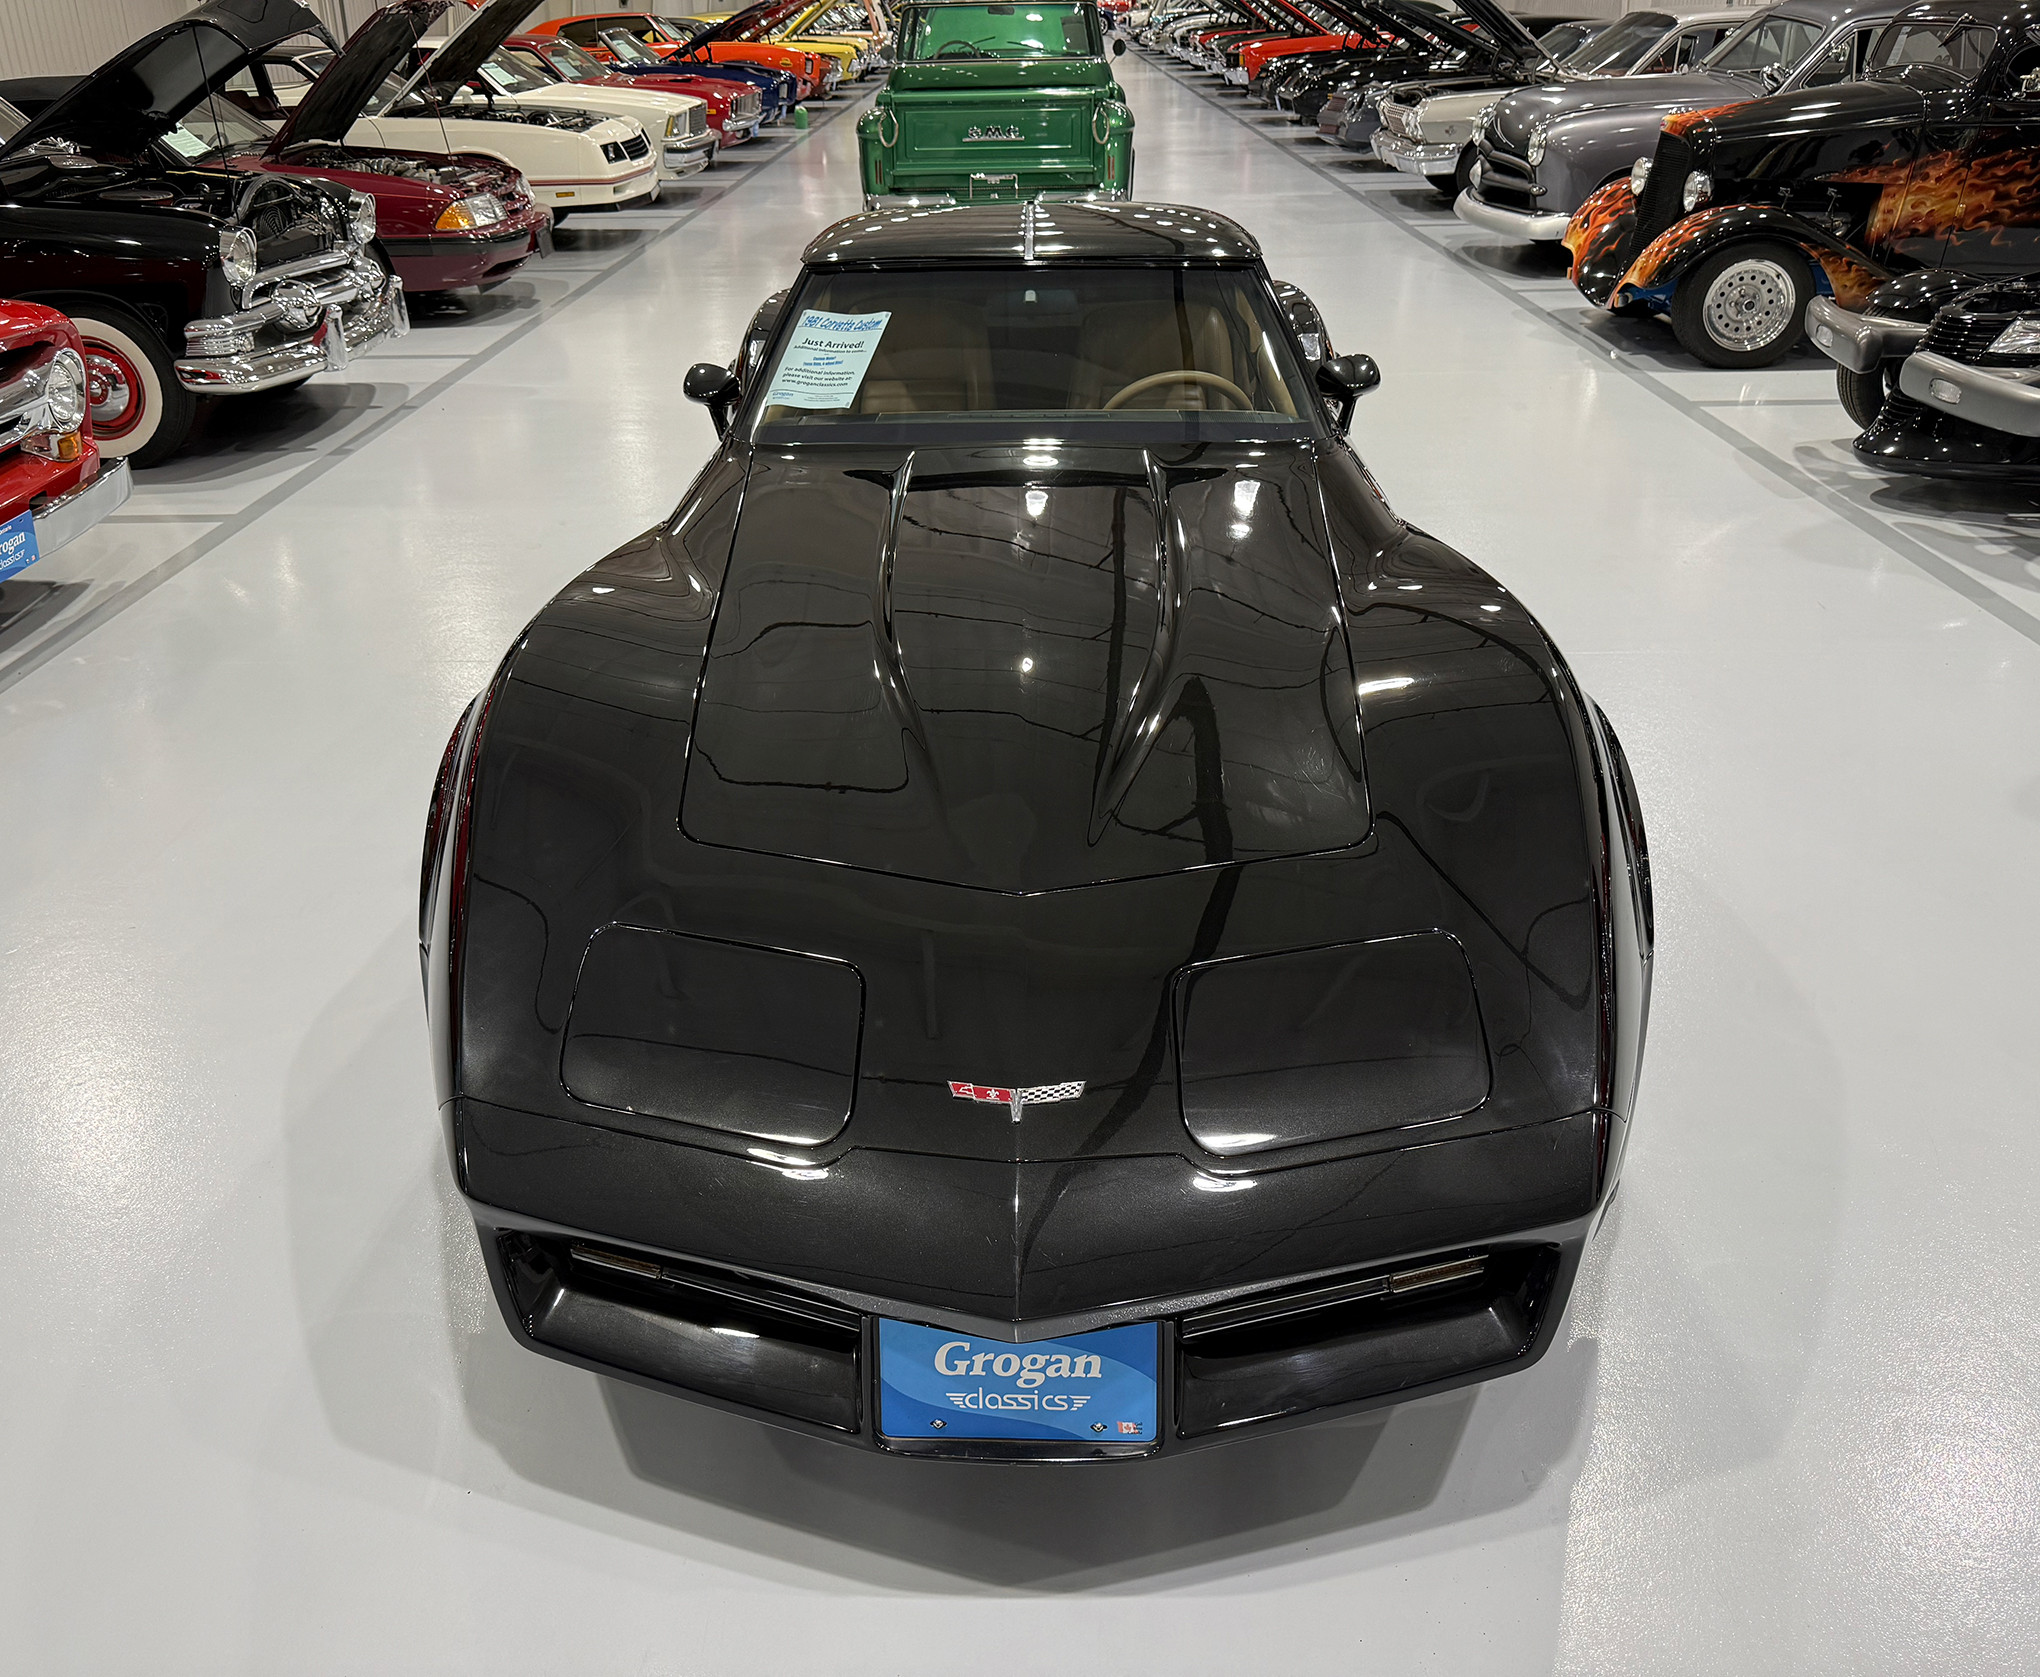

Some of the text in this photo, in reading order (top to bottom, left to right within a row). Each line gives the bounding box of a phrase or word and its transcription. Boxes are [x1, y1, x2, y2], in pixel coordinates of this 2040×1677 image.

[820, 317, 855, 331] Corvette
[802, 337, 865, 349] Just Arrived!
[794, 367, 823, 375] additional
[782, 379, 848, 387] www.groganclassics.com
[0, 531, 26, 555] rogan
[933, 1341, 1103, 1389] Grogan
[963, 1386, 1070, 1412] classics
